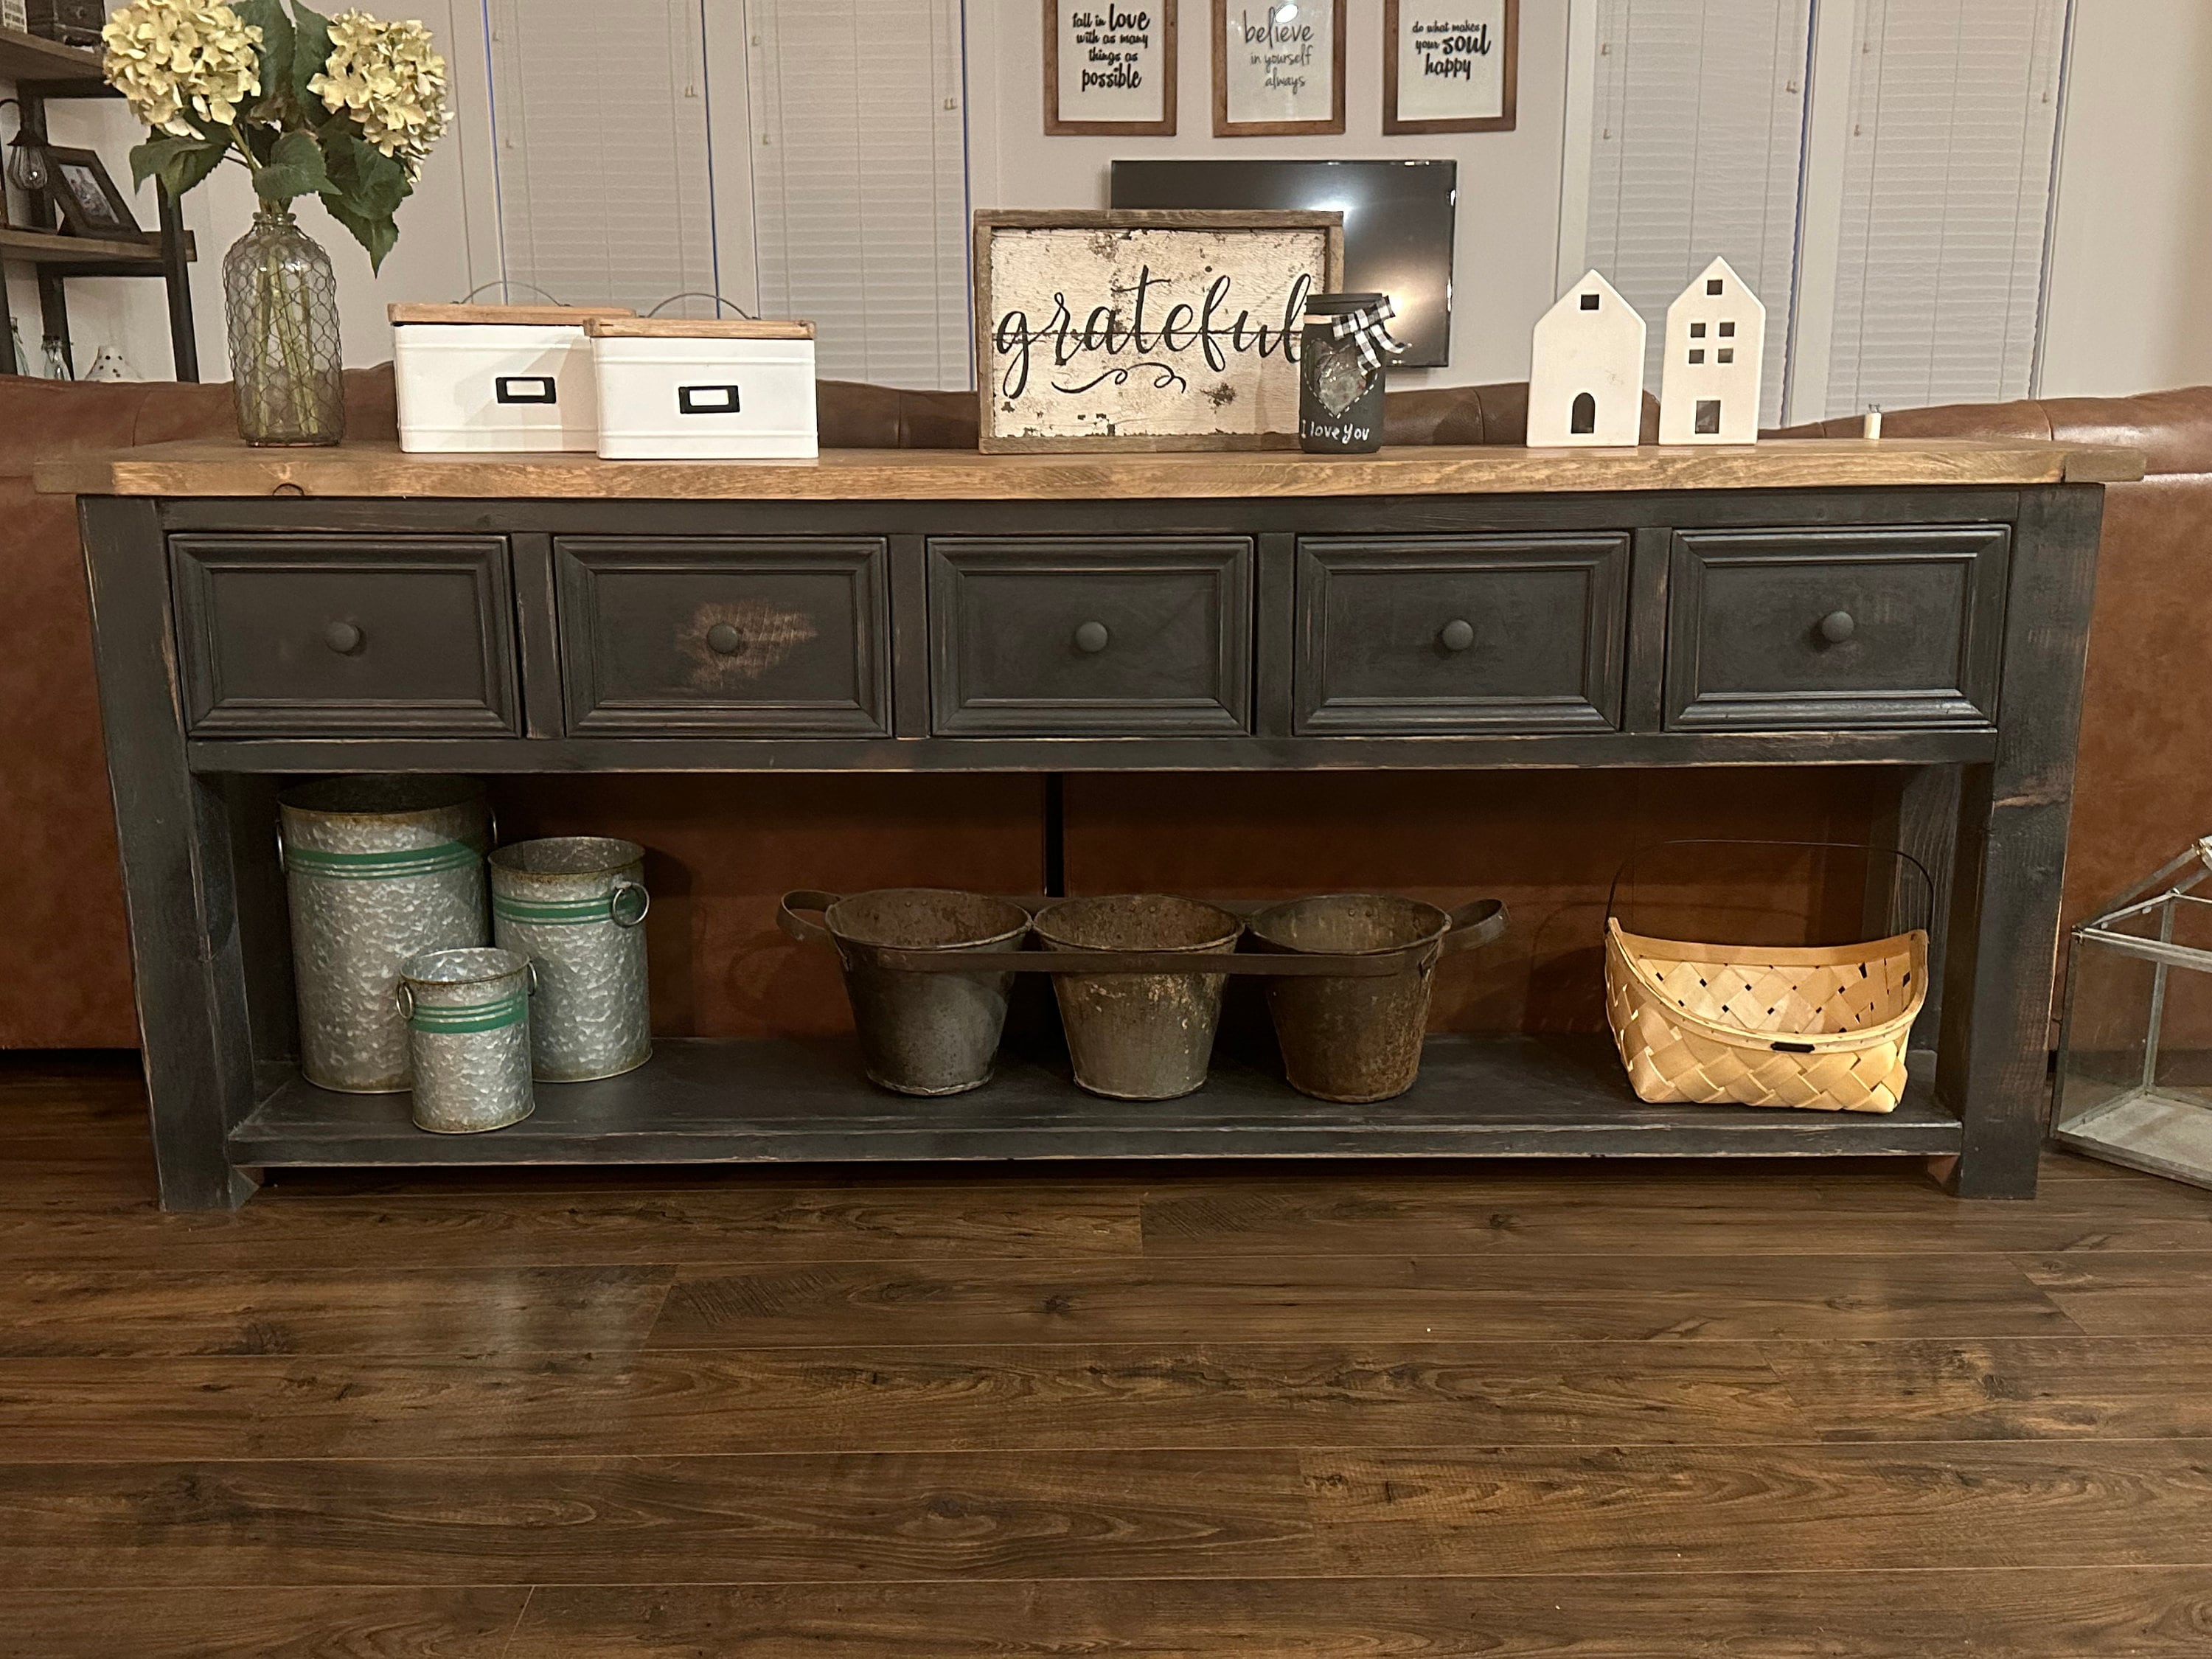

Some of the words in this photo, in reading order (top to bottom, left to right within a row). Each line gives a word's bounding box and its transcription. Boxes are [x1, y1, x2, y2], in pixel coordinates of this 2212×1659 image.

[1072, 13, 1093, 28] fall
[1095, 15, 1106, 27] in
[1109, 3, 1150, 31] love
[1243, 7, 1315, 49] believe
[1412, 21, 1424, 33] do
[1427, 20, 1449, 32] what
[1452, 20, 1480, 32] makes
[1077, 29, 1100, 44] with
[1102, 34, 1116, 44] as
[1120, 34, 1148, 49] many
[1415, 40, 1440, 55] your
[1442, 24, 1492, 55] soul
[1088, 46, 1121, 66] things
[1124, 52, 1138, 62] as
[1251, 52, 1262, 65] in
[1265, 44, 1314, 73] yourself
[1425, 52, 1472, 81] happy
[1082, 63, 1142, 91] possible
[1265, 67, 1306, 95] always
[996, 265, 1312, 399] grateful
[1301, 419, 1307, 439] I
[1310, 421, 1338, 440] love
